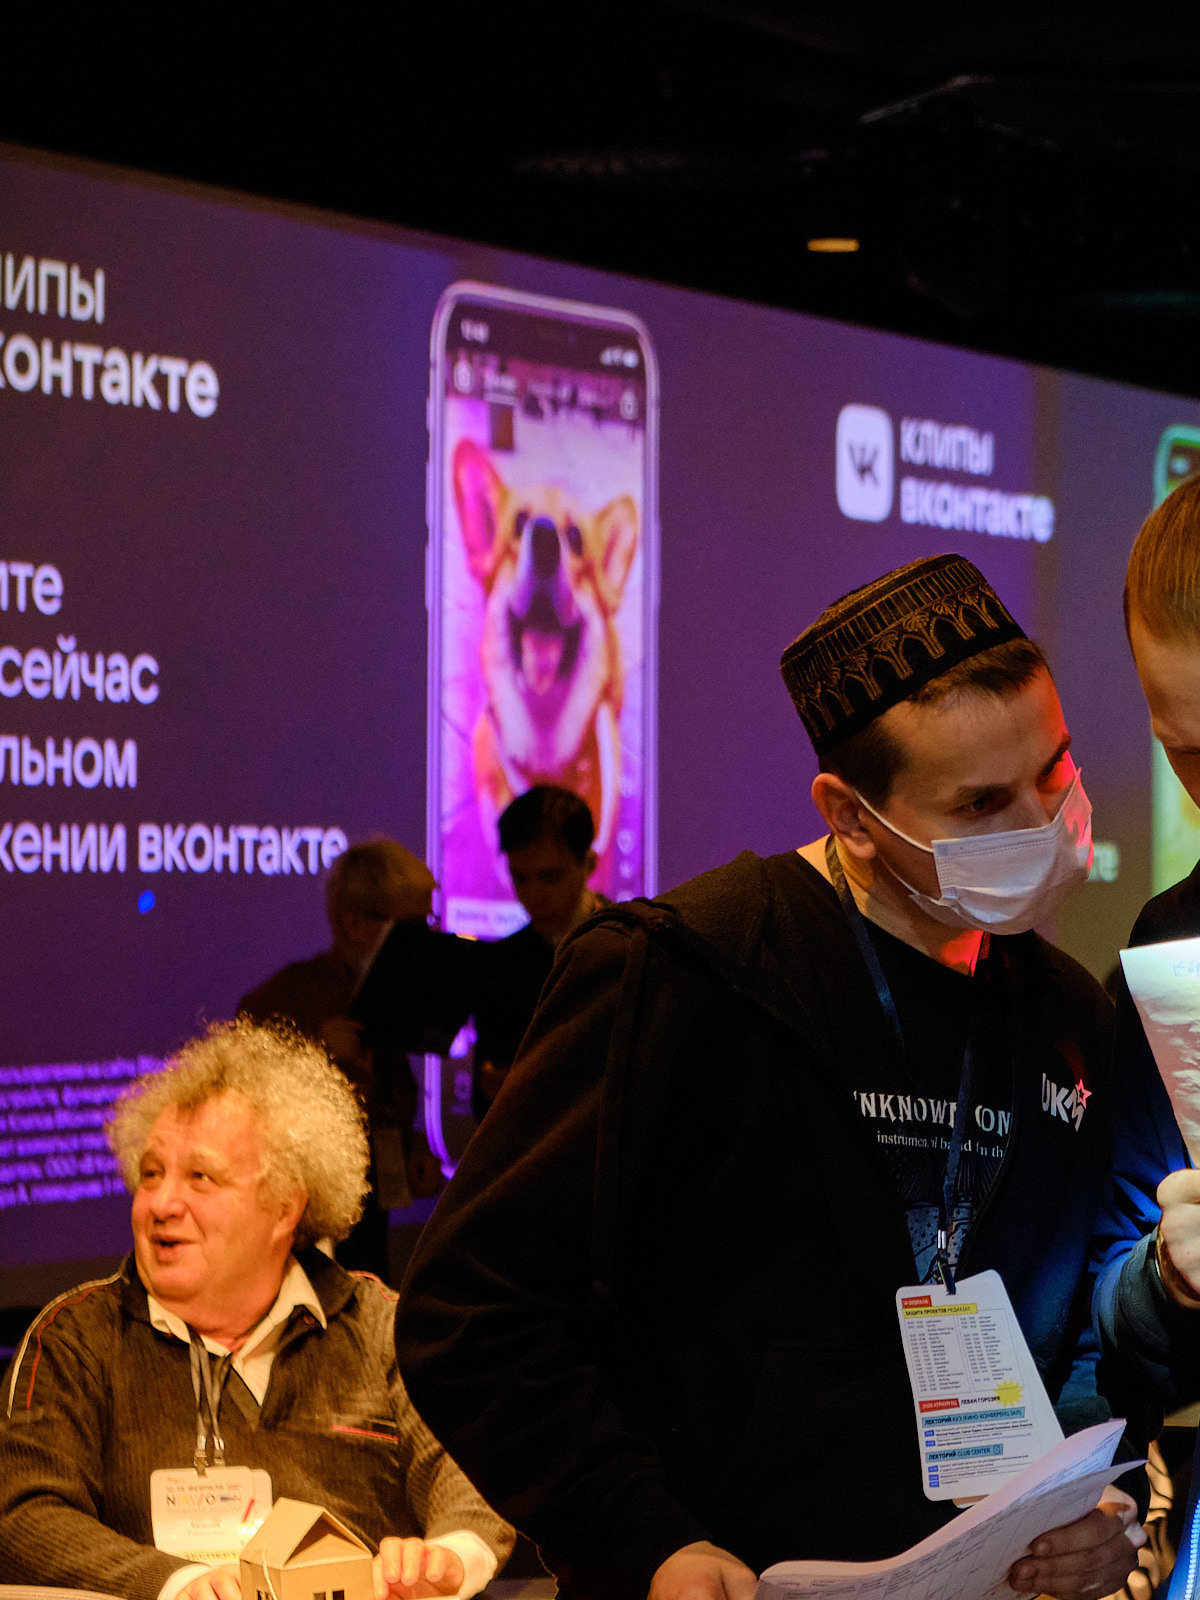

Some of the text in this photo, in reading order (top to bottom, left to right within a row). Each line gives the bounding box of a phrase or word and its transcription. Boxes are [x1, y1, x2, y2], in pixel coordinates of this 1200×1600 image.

[0, 252, 105, 325] ипы
[0, 330, 220, 418] онтакте
[0, 633, 160, 706] сейчас
